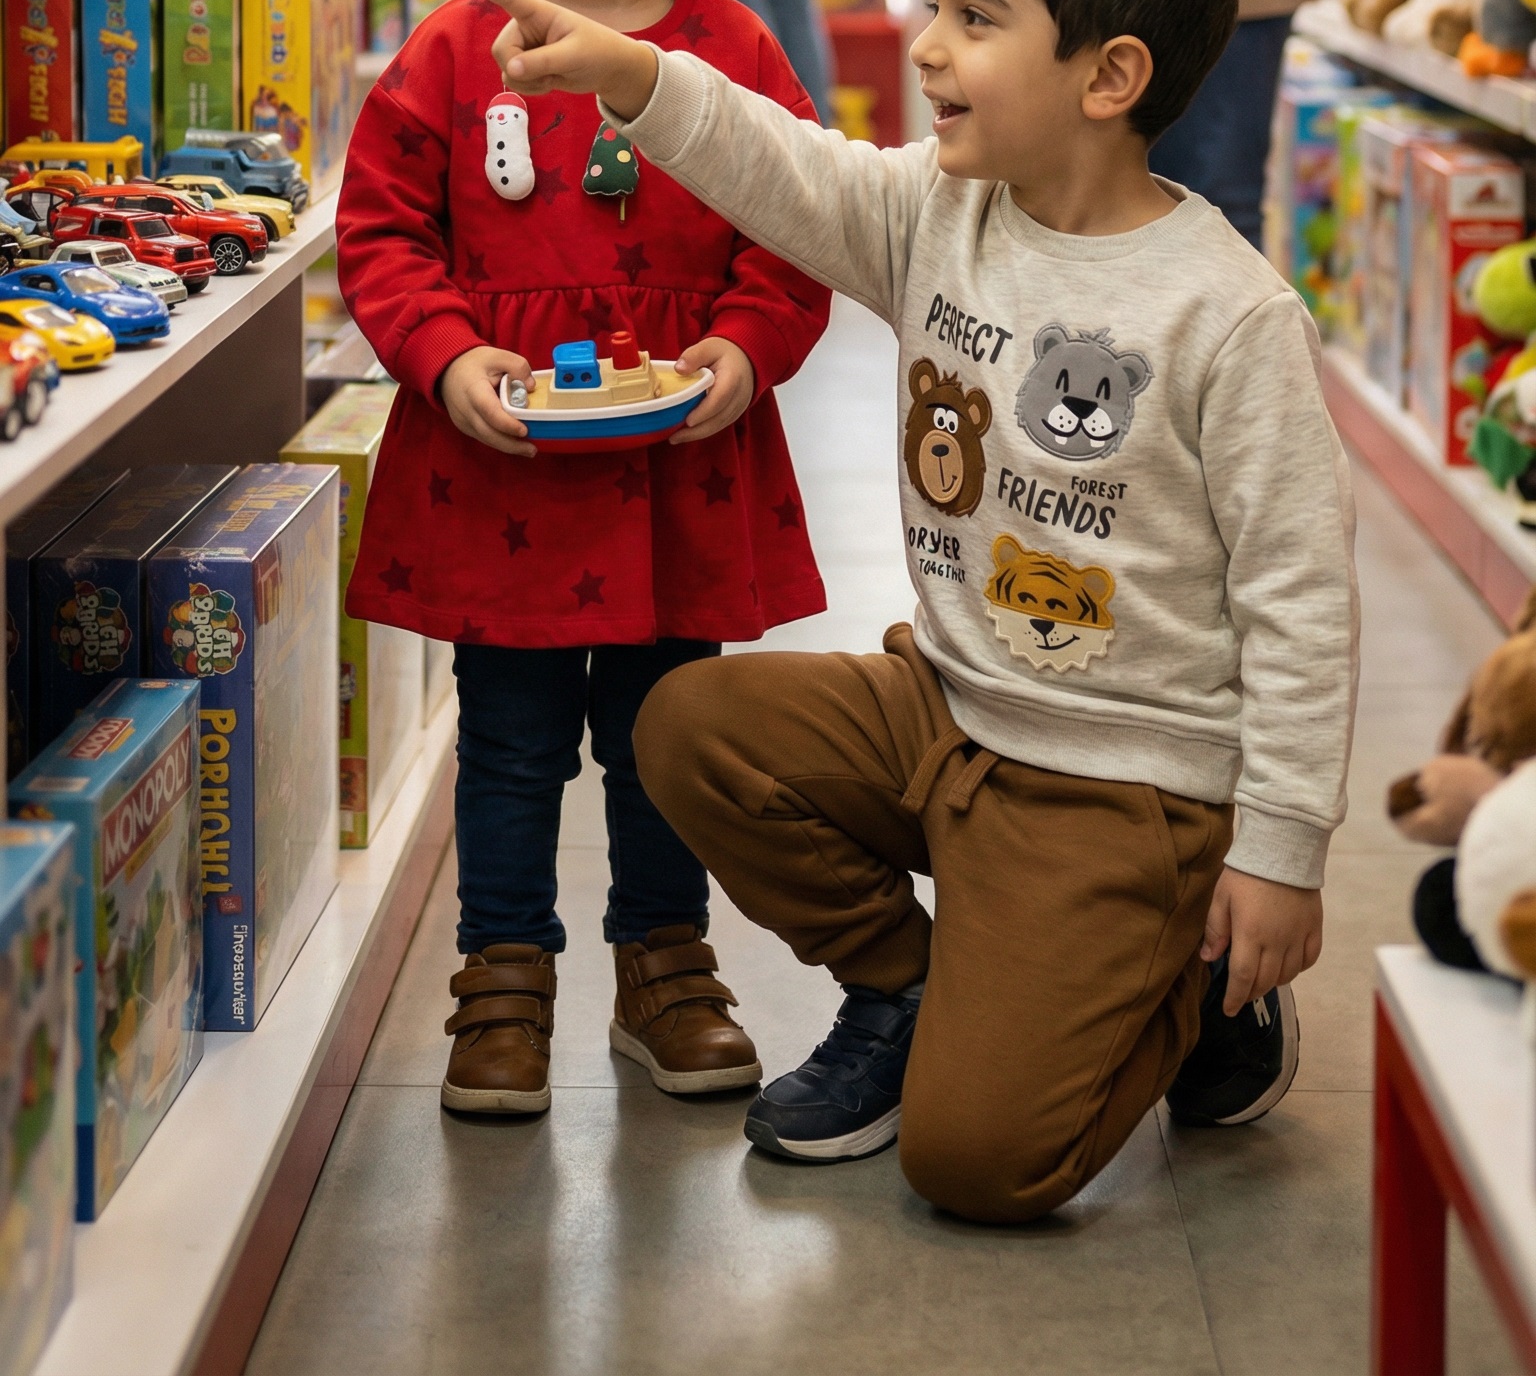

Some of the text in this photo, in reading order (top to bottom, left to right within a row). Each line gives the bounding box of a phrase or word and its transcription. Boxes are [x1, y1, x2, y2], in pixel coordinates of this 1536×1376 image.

[925, 293, 1013, 365] PERFECT
[997, 467, 1116, 540] FRIENDS
[1071, 476, 1128, 500] FOREST
[105, 735, 190, 876] MONOPOLY
